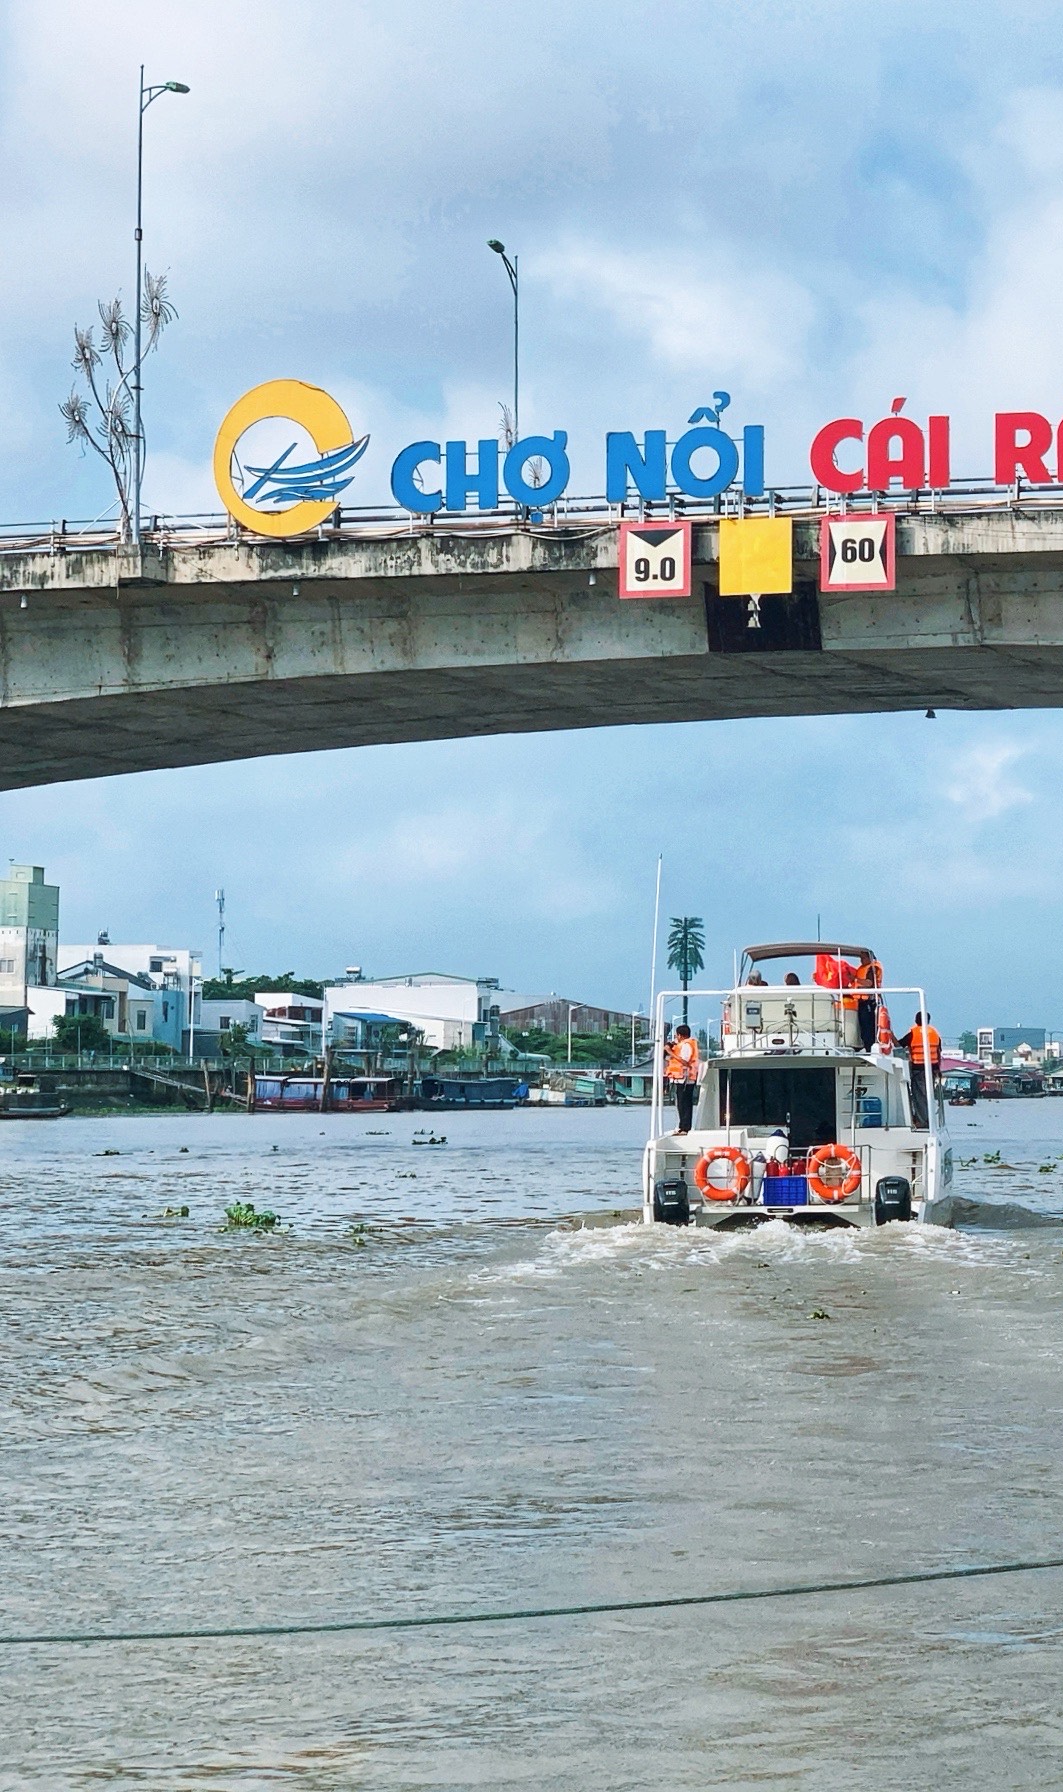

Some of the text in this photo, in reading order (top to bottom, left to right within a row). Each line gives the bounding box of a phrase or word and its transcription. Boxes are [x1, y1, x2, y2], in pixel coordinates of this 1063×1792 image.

[391, 430, 570, 524] CHỢ
[606, 391, 765, 503] NỔI
[810, 397, 950, 493] CÁI
[841, 537, 875, 563] 60
[634, 557, 676, 581] 9.0
